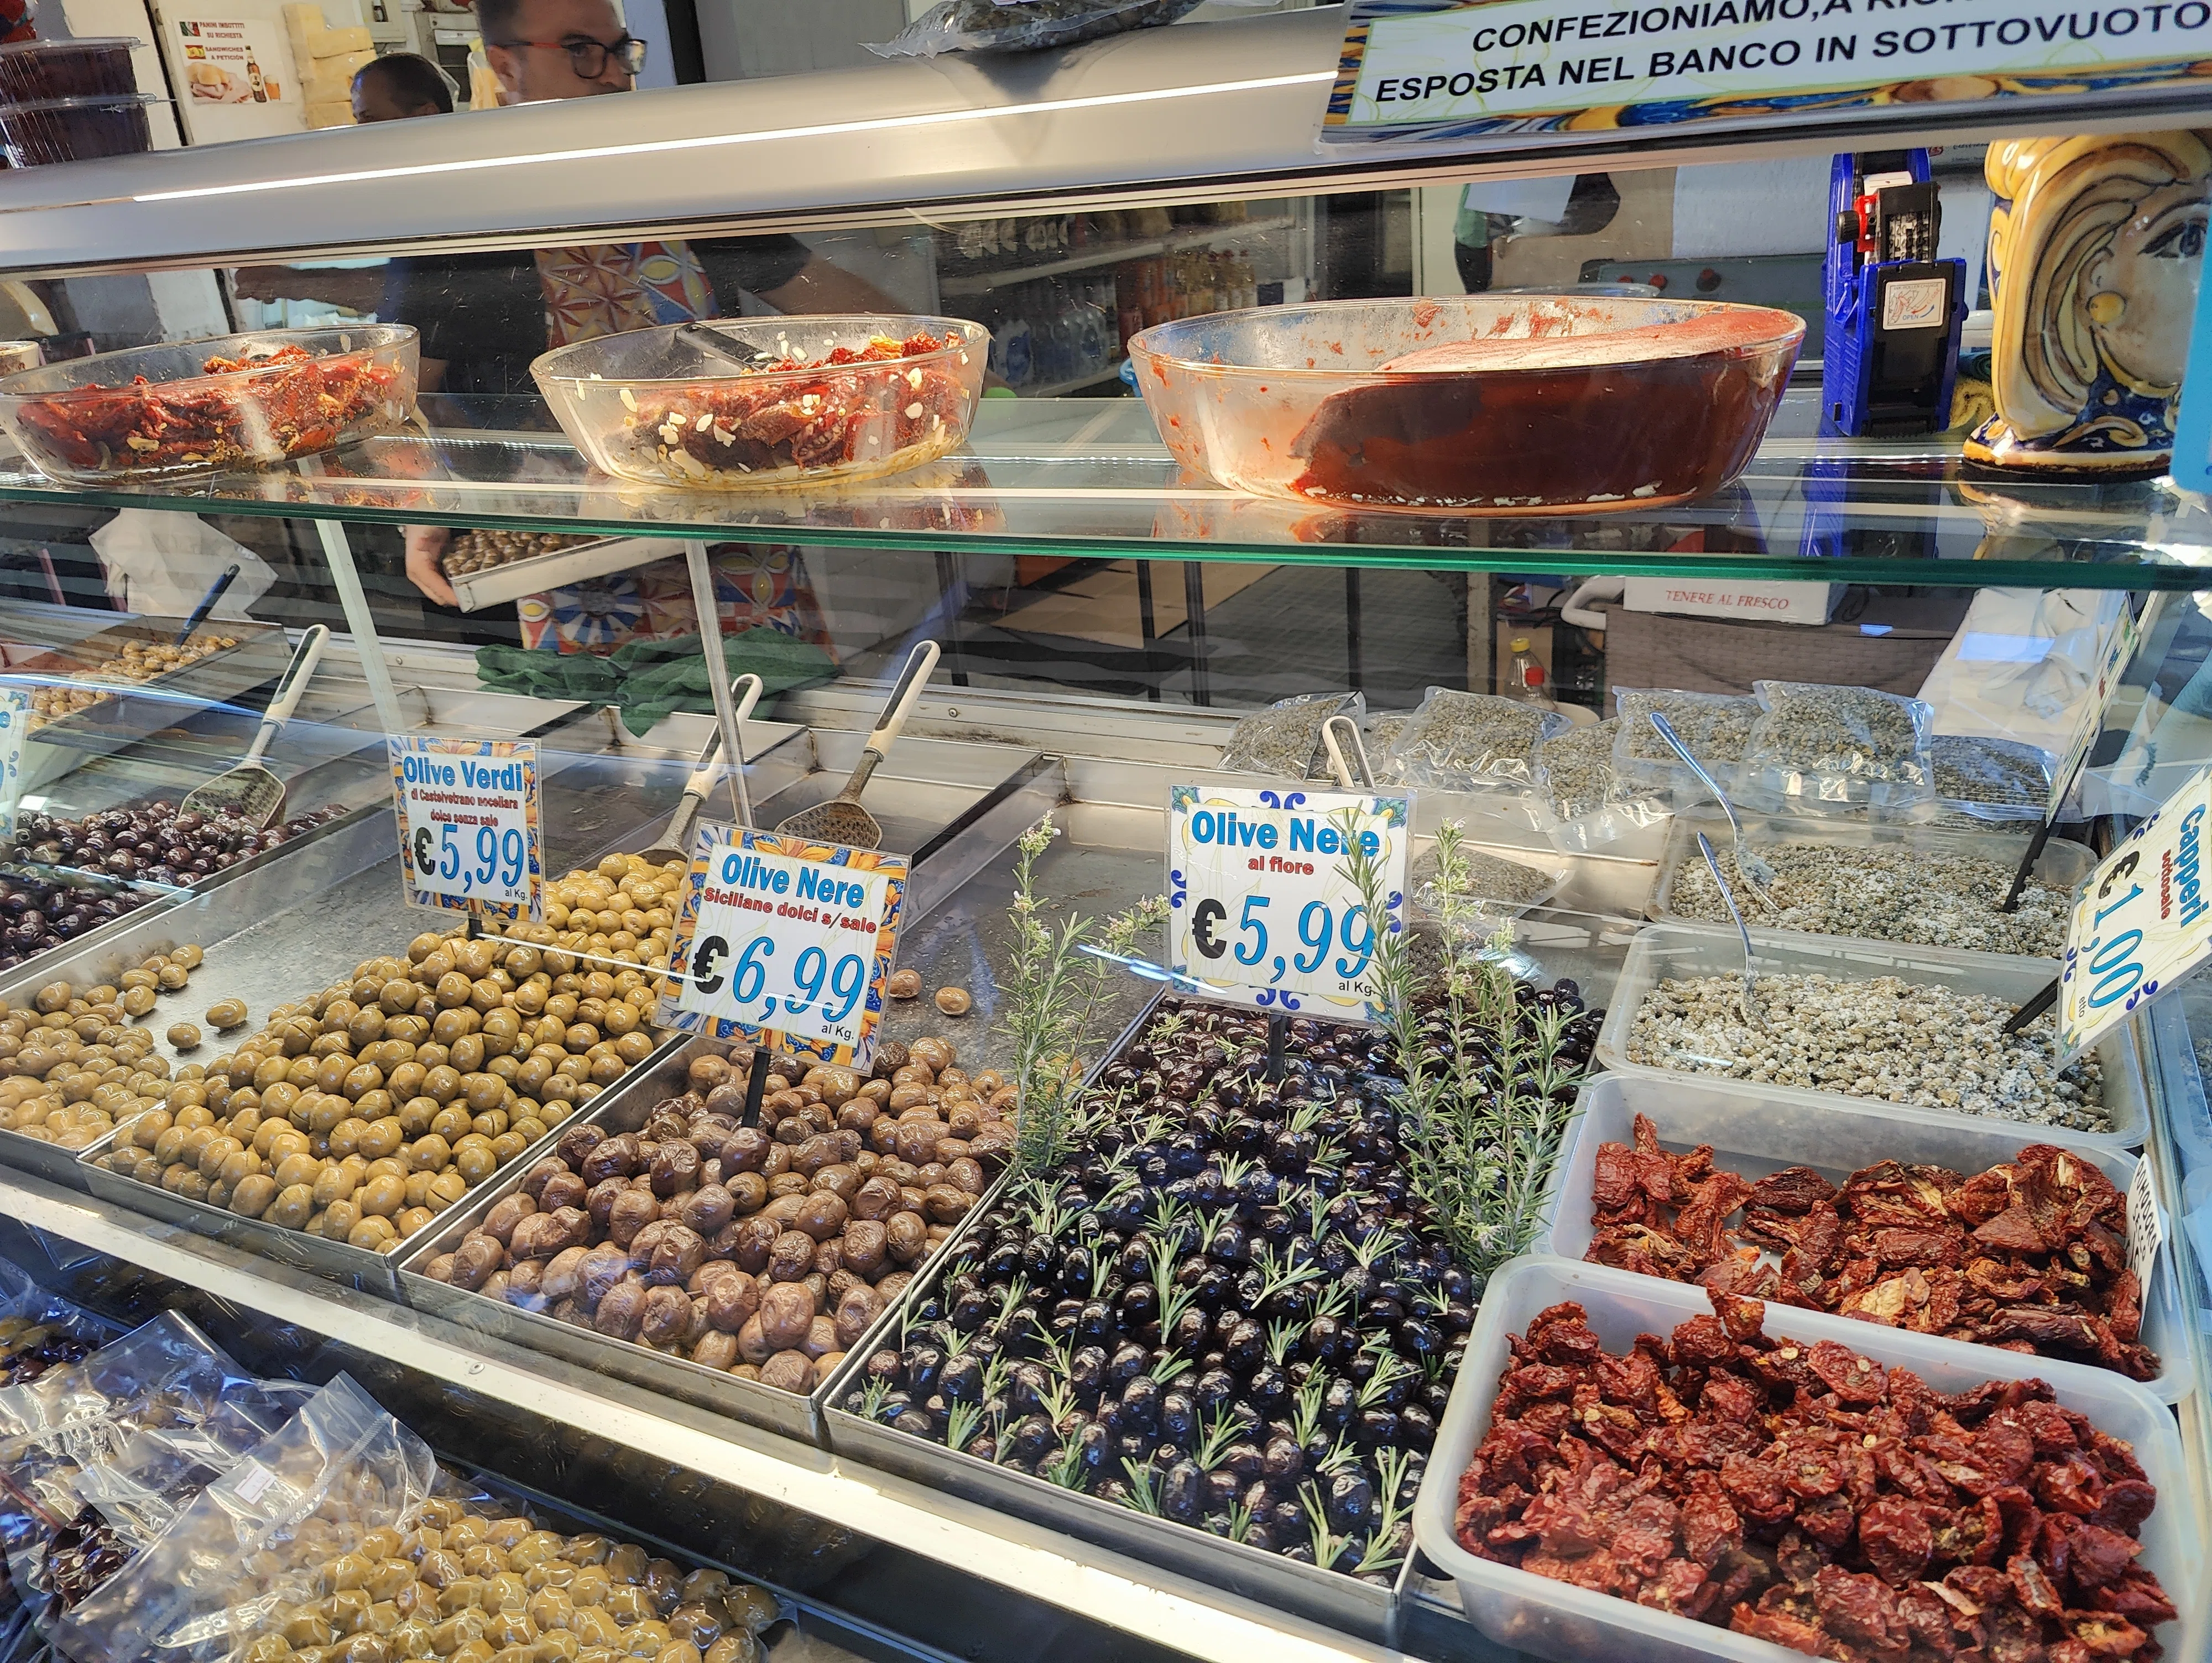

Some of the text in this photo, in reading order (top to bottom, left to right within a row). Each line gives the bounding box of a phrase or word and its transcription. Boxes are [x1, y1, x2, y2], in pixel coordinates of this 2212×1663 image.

[1375, 1, 2211, 102] ESPOSTA NEL BANCO IN SOTTOVUOTO
[1666, 590, 1789, 610] TENERE AL FRESCO
[403, 756, 523, 792] Olive Verdi
[411, 788, 418, 800] di
[430, 808, 499, 827] dolce senza sale
[1192, 810, 1278, 849] Olive
[722, 853, 865, 908] Olive Nere
[1248, 855, 1314, 876] al fiore
[2174, 803, 2209, 928] Capperi
[505, 888, 513, 897] al
[2161, 849, 2173, 920] sottosale
[703, 887, 877, 934] Siciliane dolci s/sale
[1338, 980, 1349, 992] al
[822, 1023, 831, 1034] al
[2135, 1160, 2157, 1254] POMODORO
